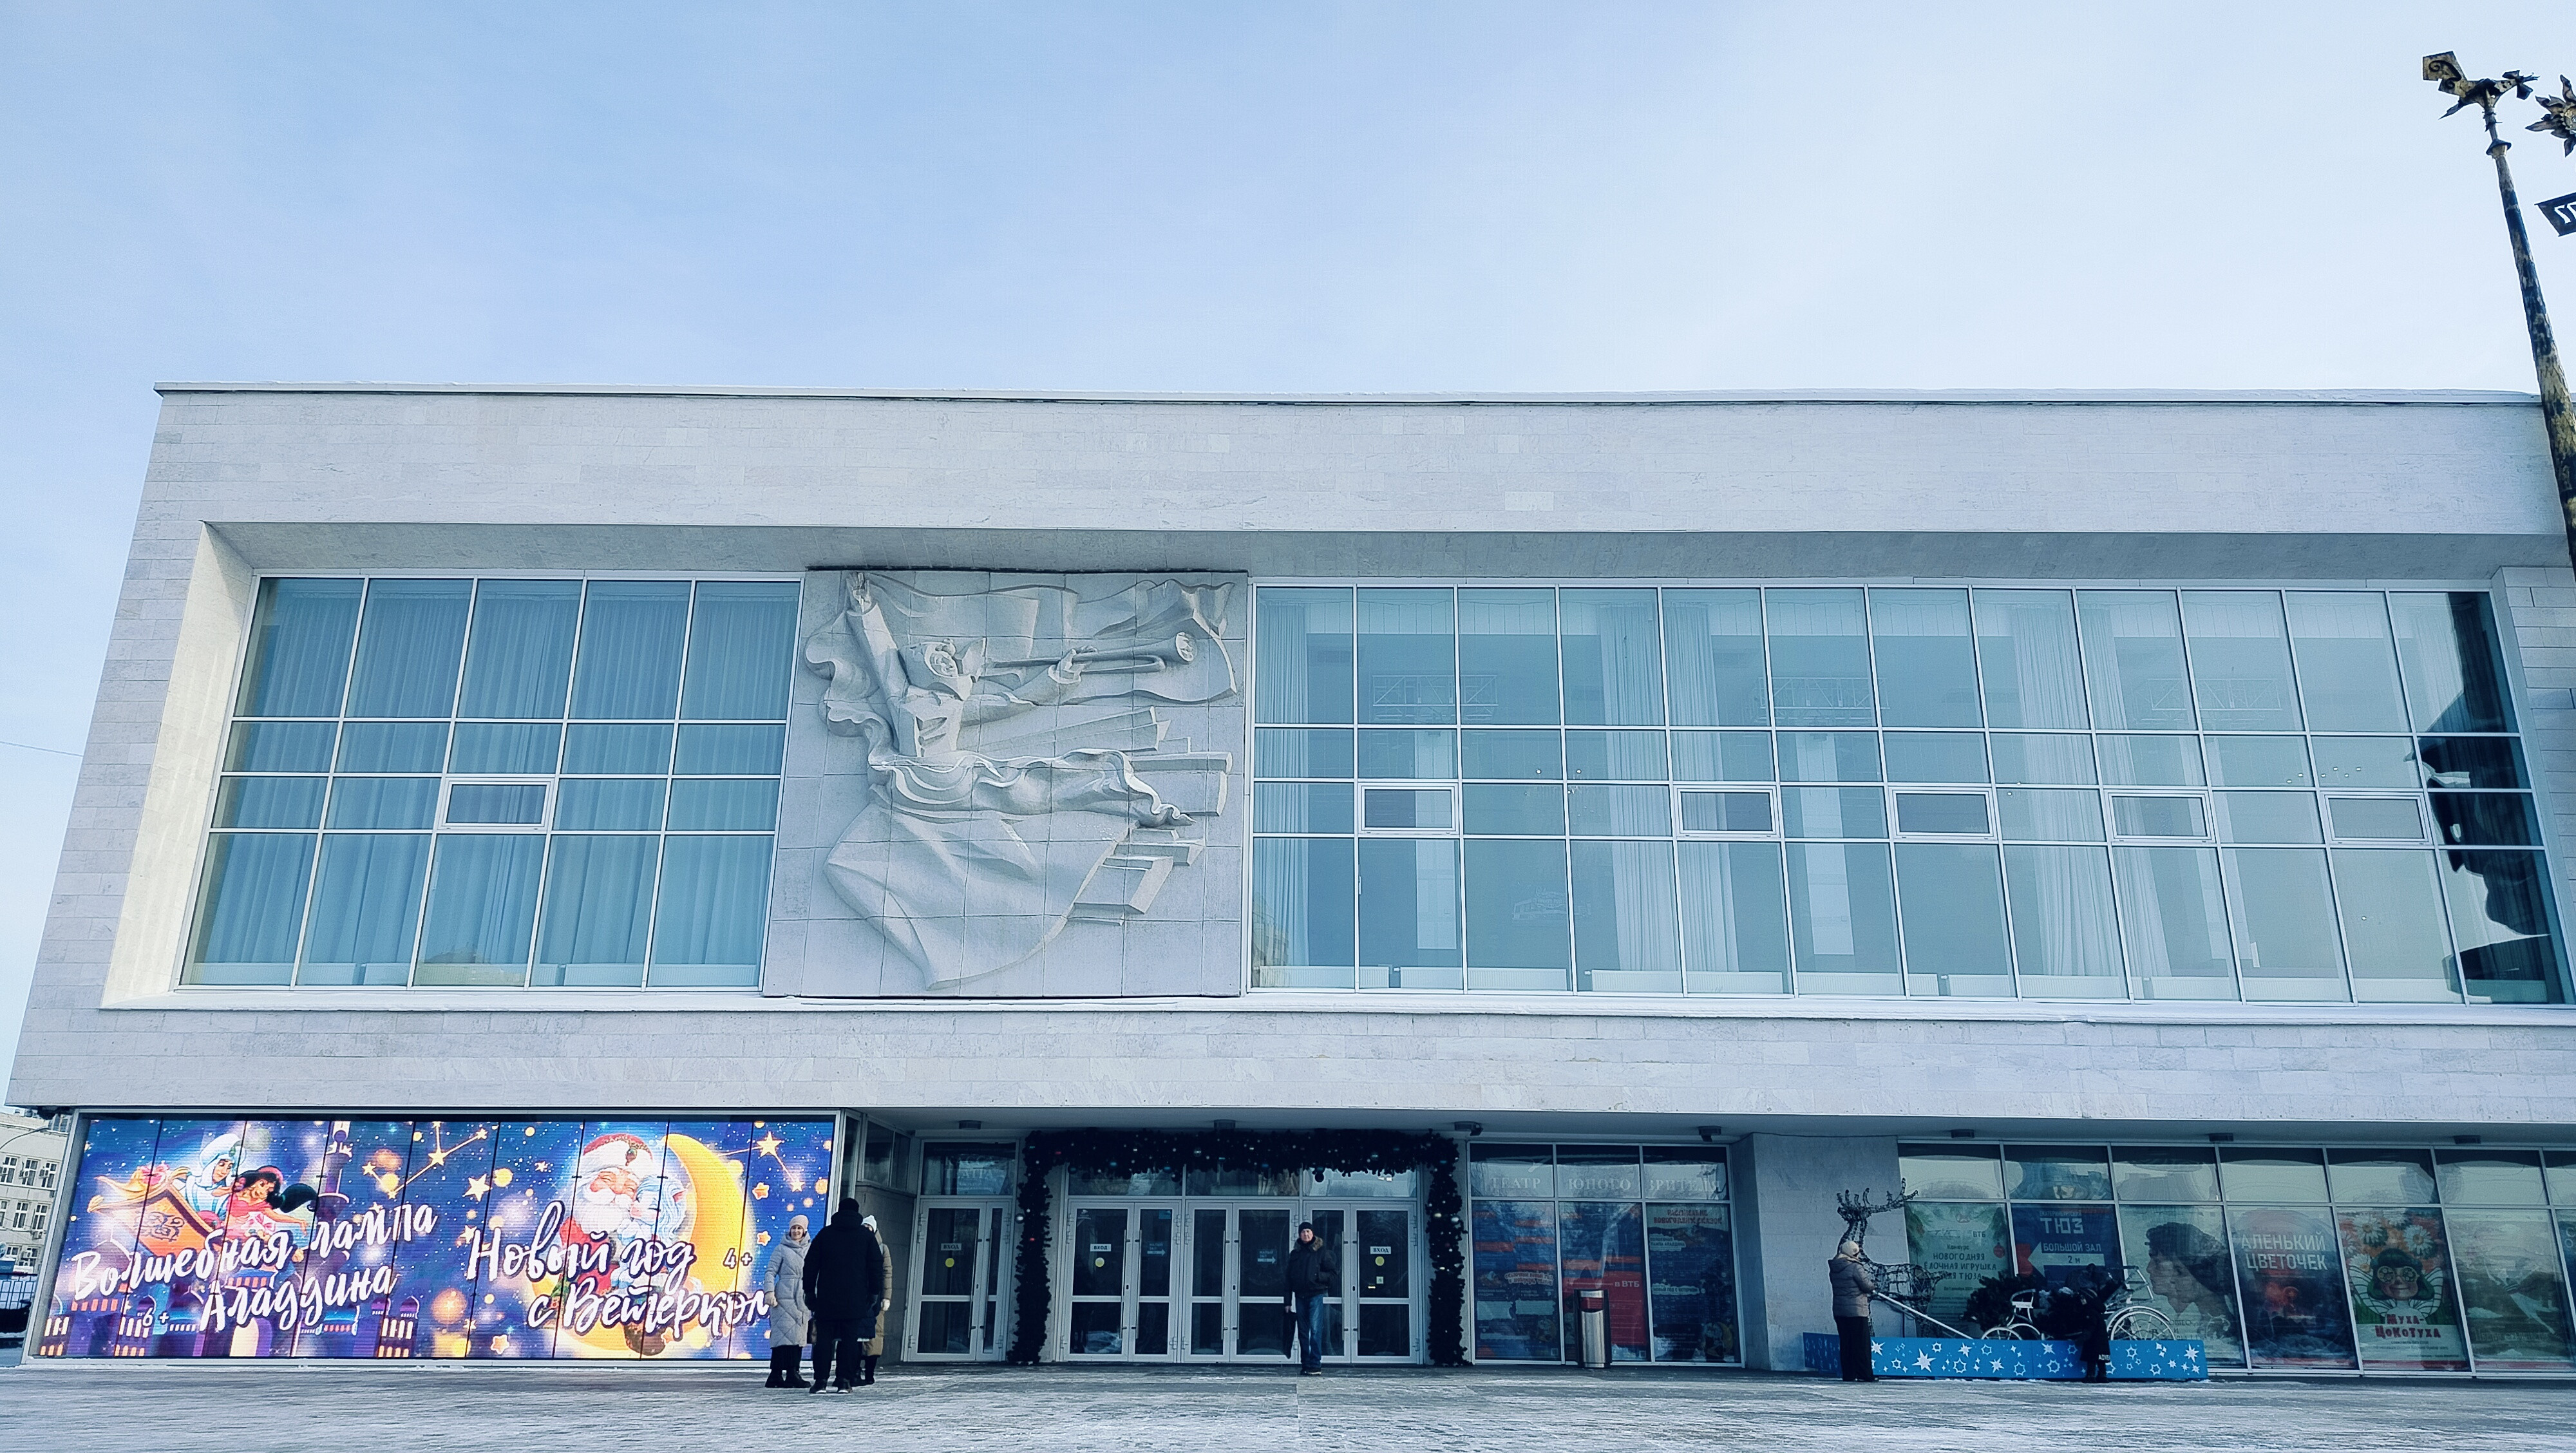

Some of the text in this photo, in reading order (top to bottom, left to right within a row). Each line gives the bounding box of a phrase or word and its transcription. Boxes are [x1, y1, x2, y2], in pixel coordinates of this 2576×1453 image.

[1492, 1177, 1720, 1193] ТЕАТР ЮНОГО ЗРИТЕЛЯ
[2040, 1217, 2084, 1234] ТЮЗ
[465, 1201, 694, 1296] Новый год
[2043, 1241, 2102, 1252] БОЛЬШОЙ ЗАЛ
[2240, 1231, 2326, 1251] АЛЕНЬКИЙ
[72, 1202, 439, 1300] Волшебная лампа
[1933, 1252, 1985, 1261] НОВОГОДНЯЯ
[2067, 1255, 2073, 1264] 2
[1924, 1261, 1996, 1271] ЁЛОЧНАЯ ИГРУШКА
[2245, 1253, 2329, 1272] ЦВЕТОЧЕК
[1958, 1272, 1982, 1280] ТЮЗА
[200, 1264, 399, 1331] Аладдина
[528, 1295, 554, 1328] с
